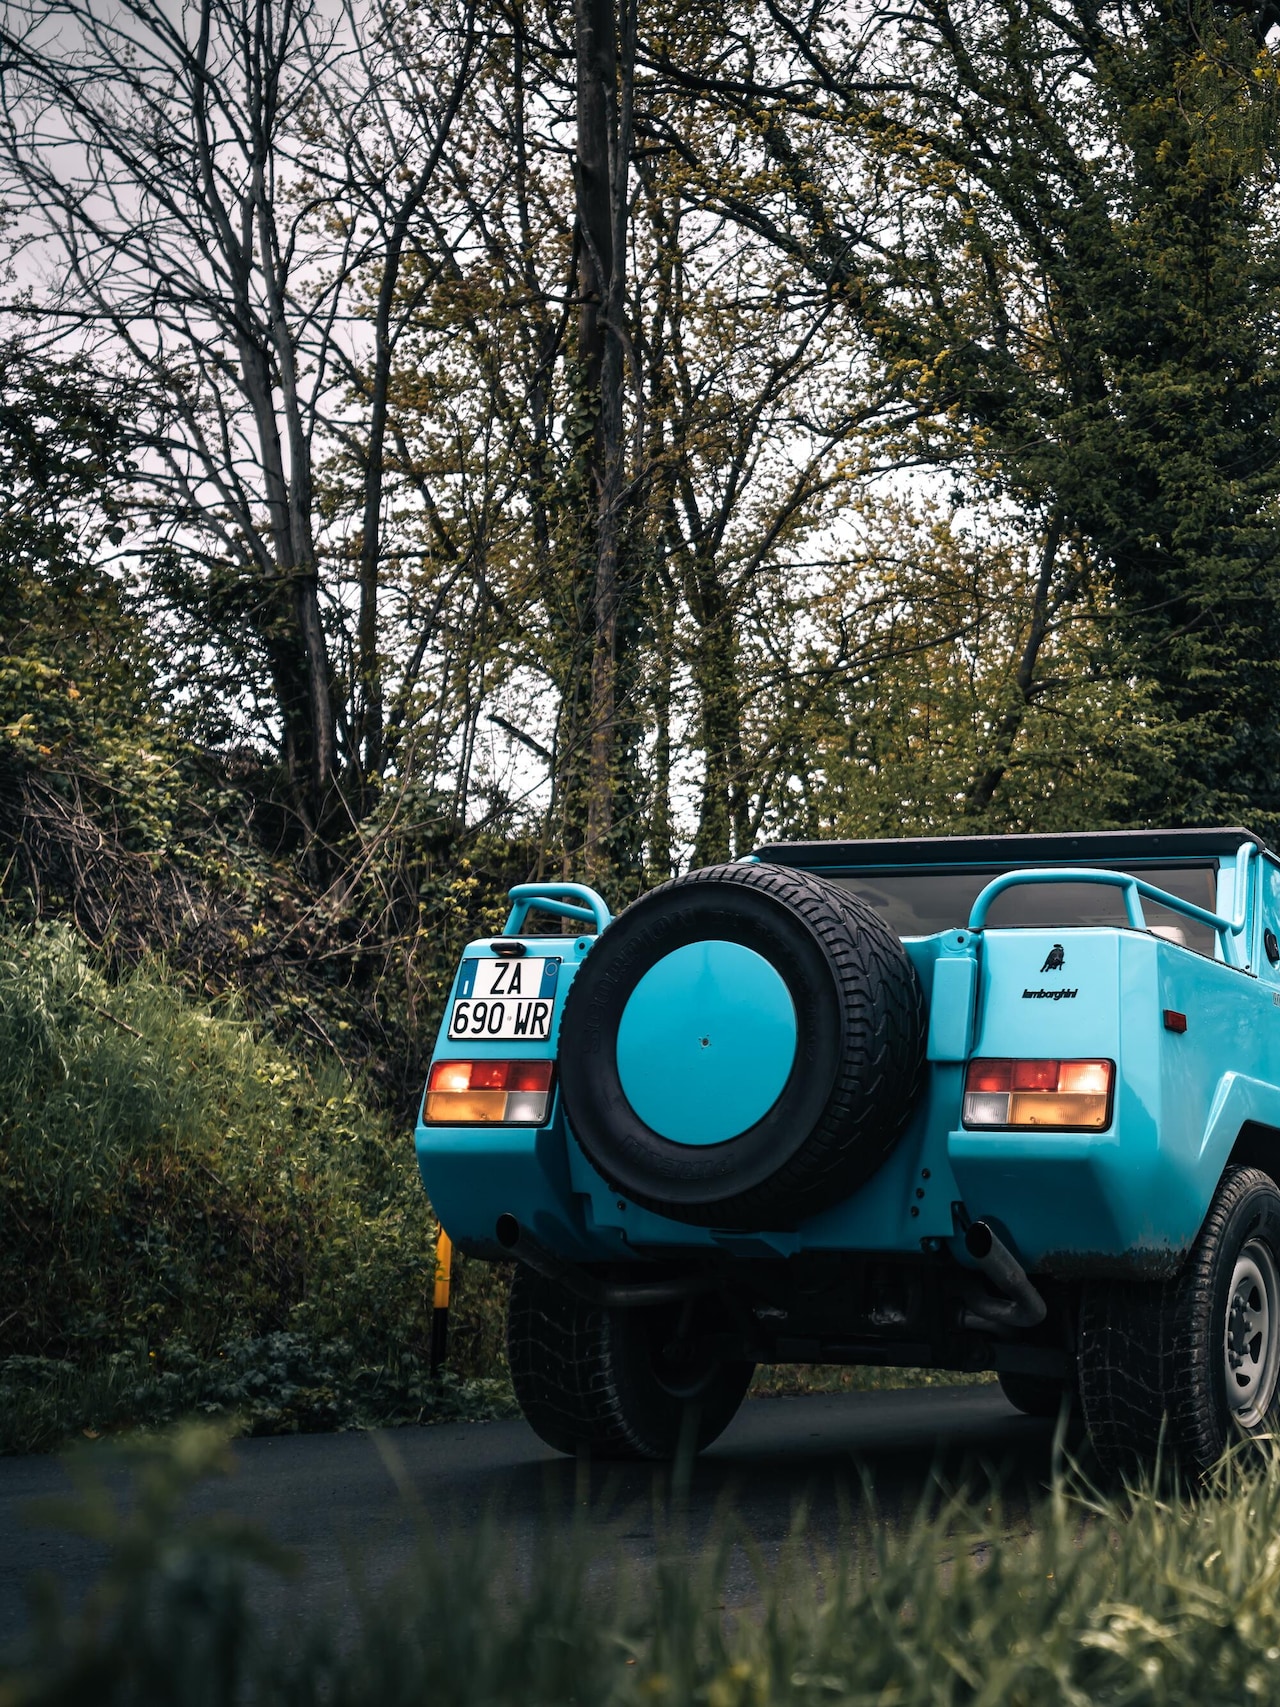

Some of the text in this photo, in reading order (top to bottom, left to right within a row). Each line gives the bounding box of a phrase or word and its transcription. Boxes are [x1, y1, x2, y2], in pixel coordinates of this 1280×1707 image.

[489, 962, 522, 995] ZA
[453, 1001, 549, 1035] 690 WR
